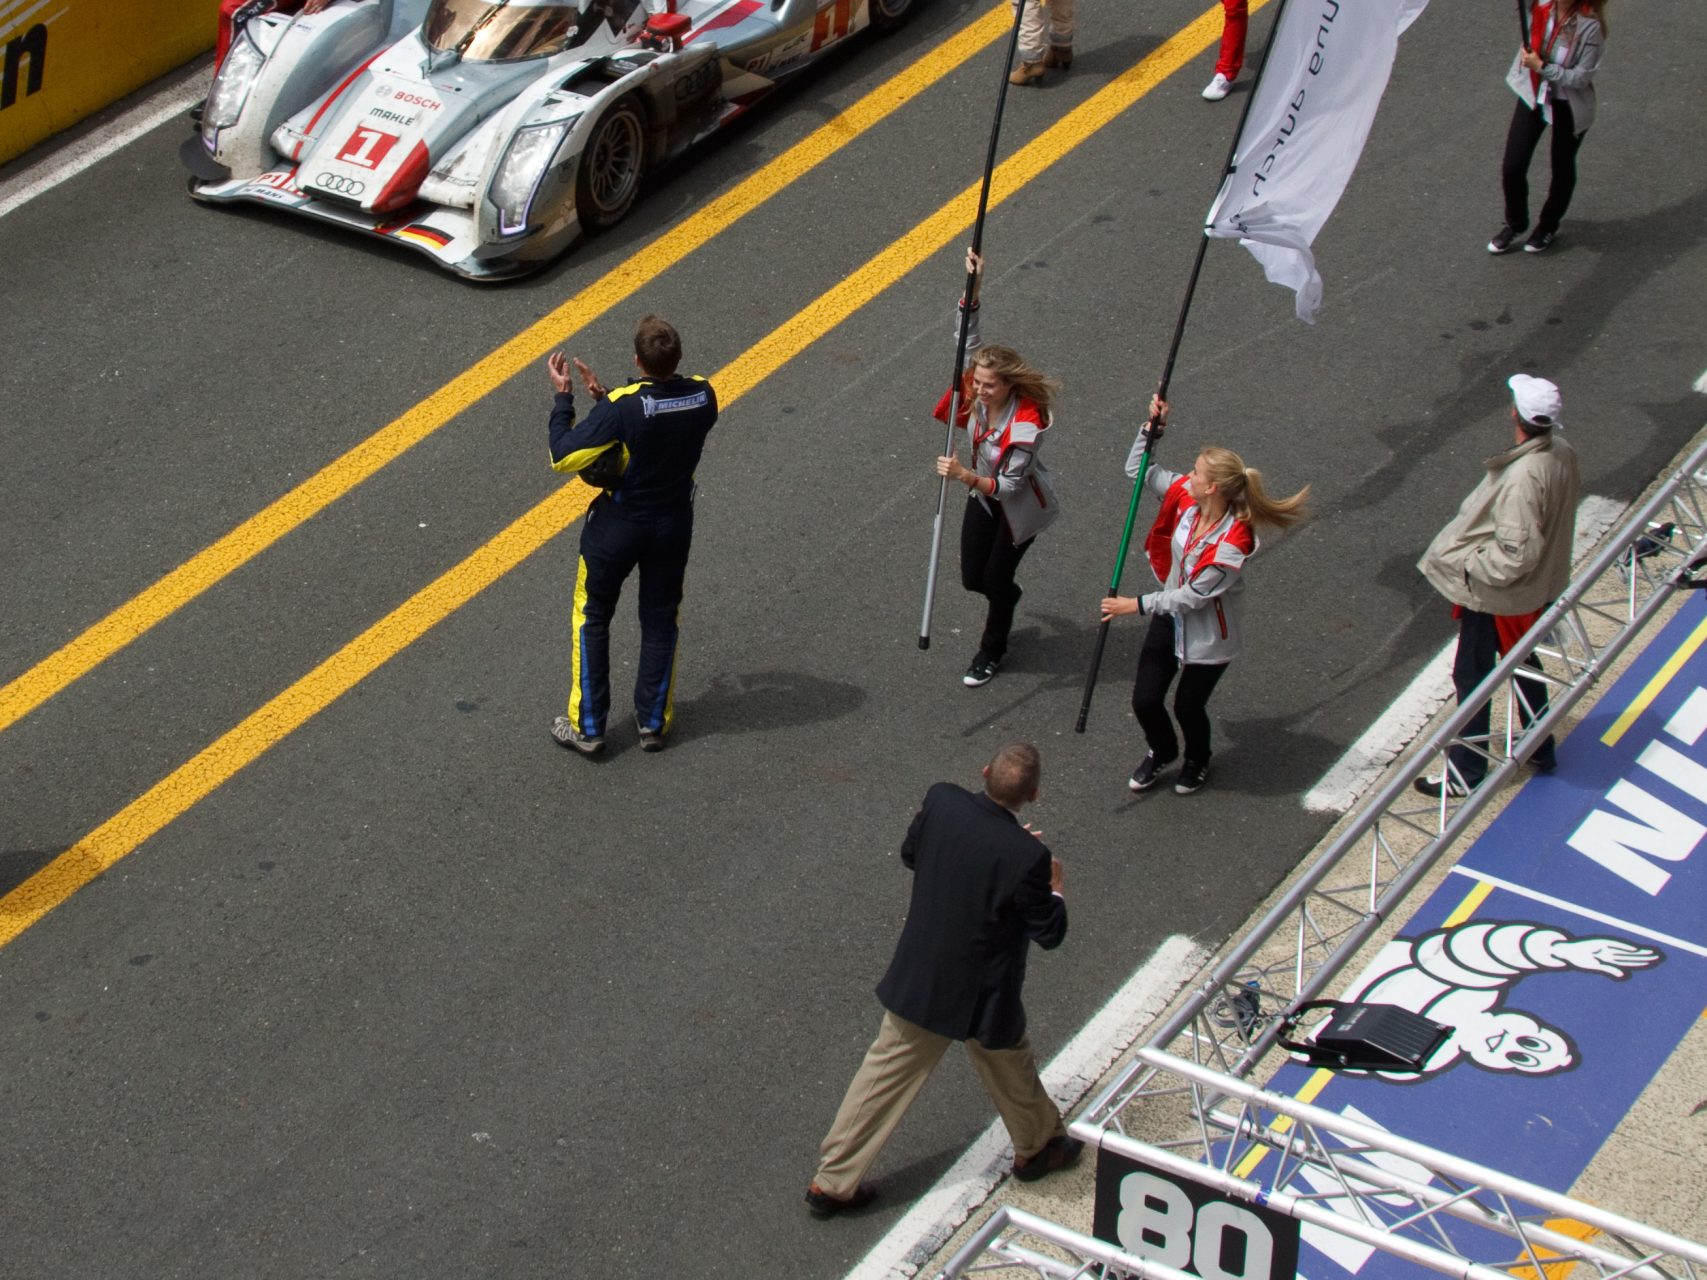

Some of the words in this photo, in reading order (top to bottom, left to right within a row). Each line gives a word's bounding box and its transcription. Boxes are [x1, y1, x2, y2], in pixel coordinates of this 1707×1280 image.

[819, 3, 839, 45] 1
[394, 91, 441, 111] BOSCH
[369, 107, 415, 126] MAHLE
[341, 130, 384, 168] 1
[658, 394, 706, 409] MICHELIN
[1117, 1171, 1274, 1280] 80
